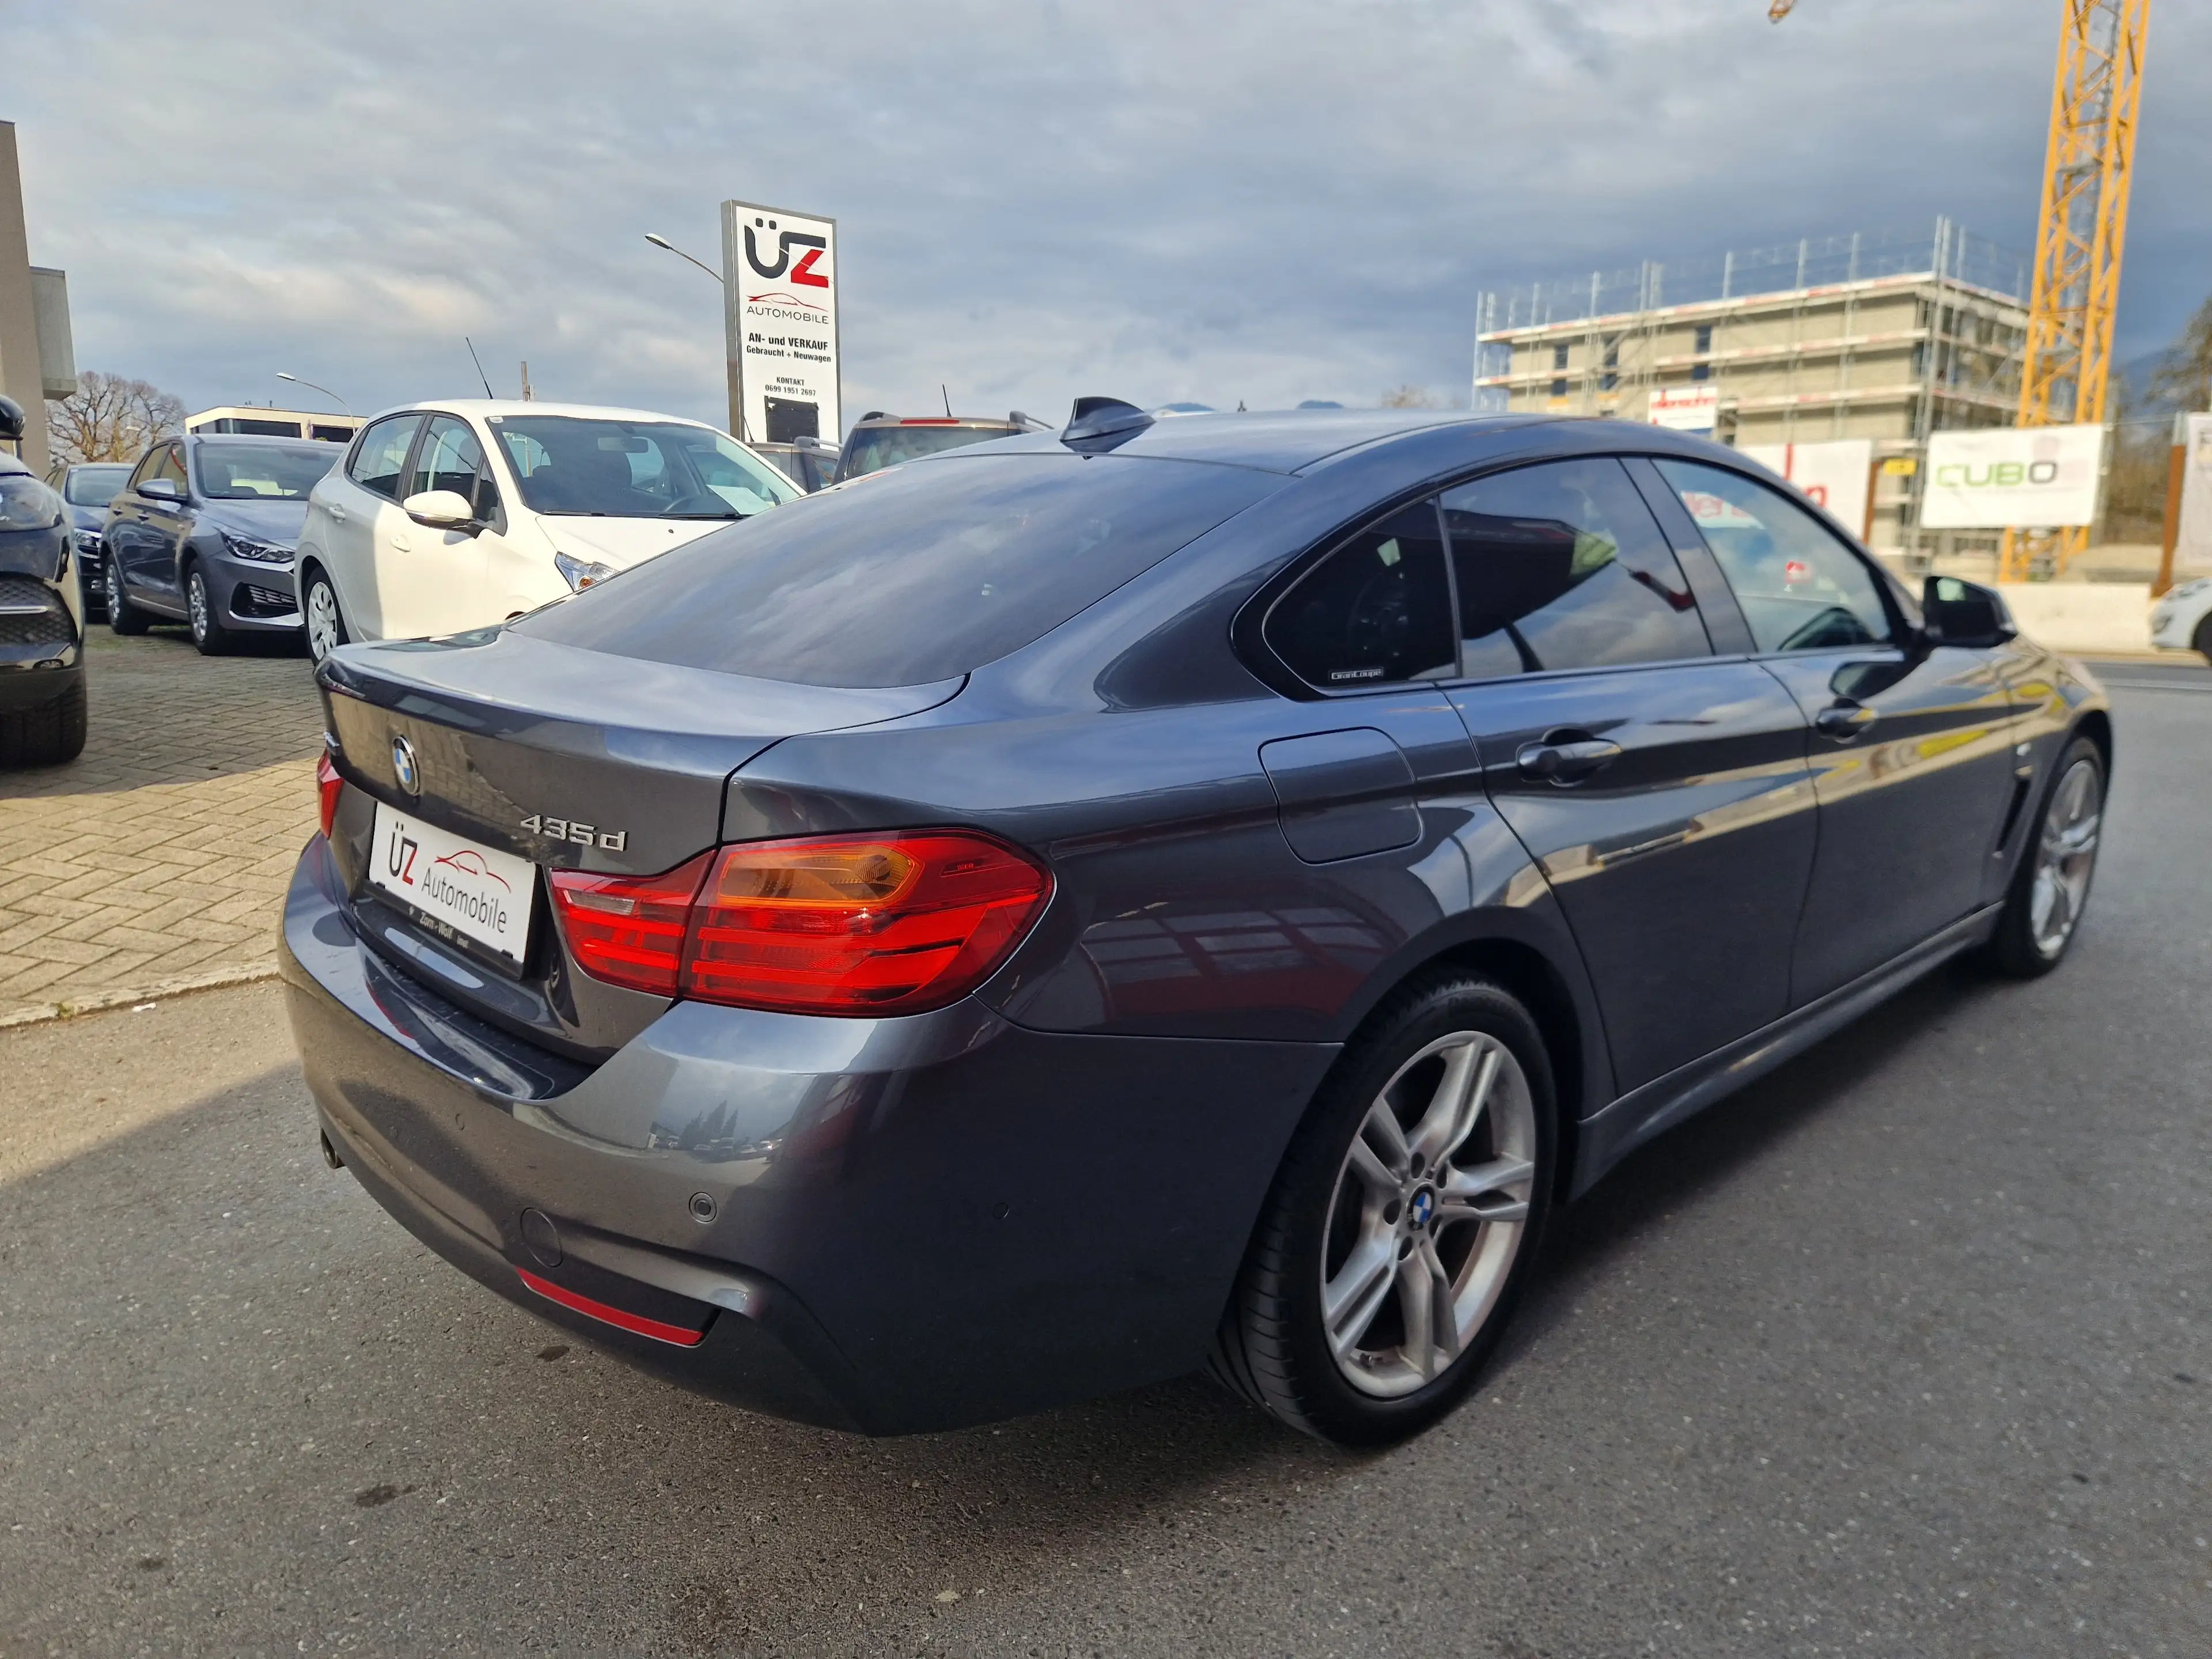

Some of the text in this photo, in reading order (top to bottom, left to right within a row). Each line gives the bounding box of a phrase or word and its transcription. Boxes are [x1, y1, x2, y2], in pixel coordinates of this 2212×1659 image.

[744, 217, 829, 289] ÜZ
[746, 305, 830, 324] AUTOMOBILE
[748, 332, 828, 351] AN- und VERKAUF
[747, 344, 785, 358] Gebraucht
[793, 350, 832, 363] Neuwagen
[764, 384, 816, 397] 0699 1951 2697
[776, 376, 805, 387] KONTAKT
[1936, 460, 2058, 488] CUBO
[520, 813, 627, 853] 435d
[388, 821, 507, 933] ÜZ Automobile
